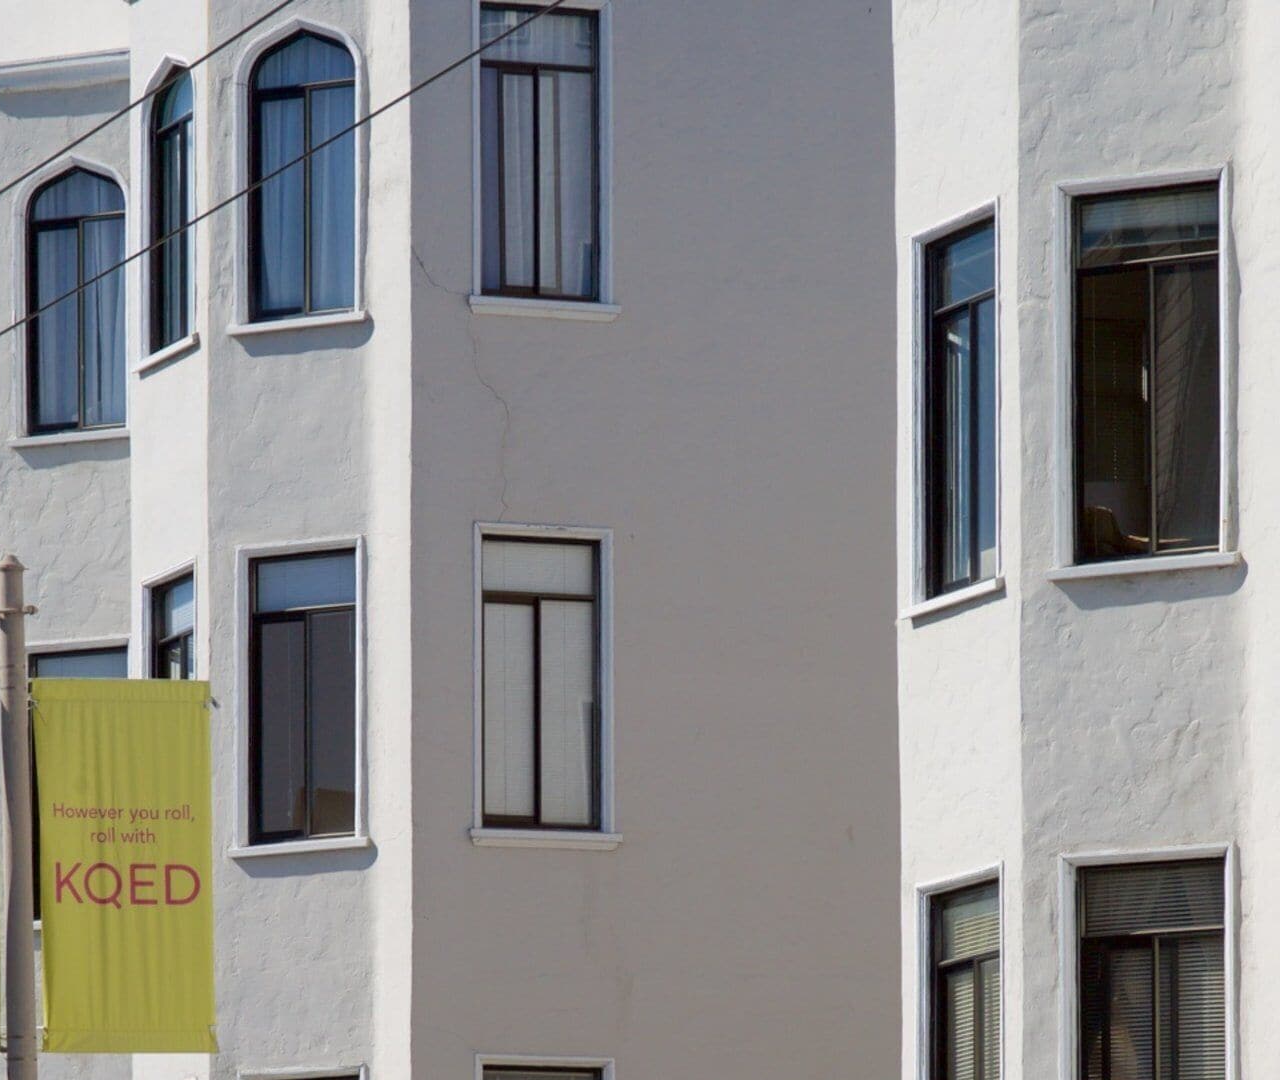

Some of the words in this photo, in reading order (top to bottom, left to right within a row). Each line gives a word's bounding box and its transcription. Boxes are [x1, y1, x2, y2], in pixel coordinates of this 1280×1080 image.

[52, 803, 124, 819] However
[129, 808, 159, 823] you
[165, 805, 195, 822] roll,
[90, 827, 116, 843] roll
[121, 828, 156, 844] with
[55, 862, 201, 909] KQED
